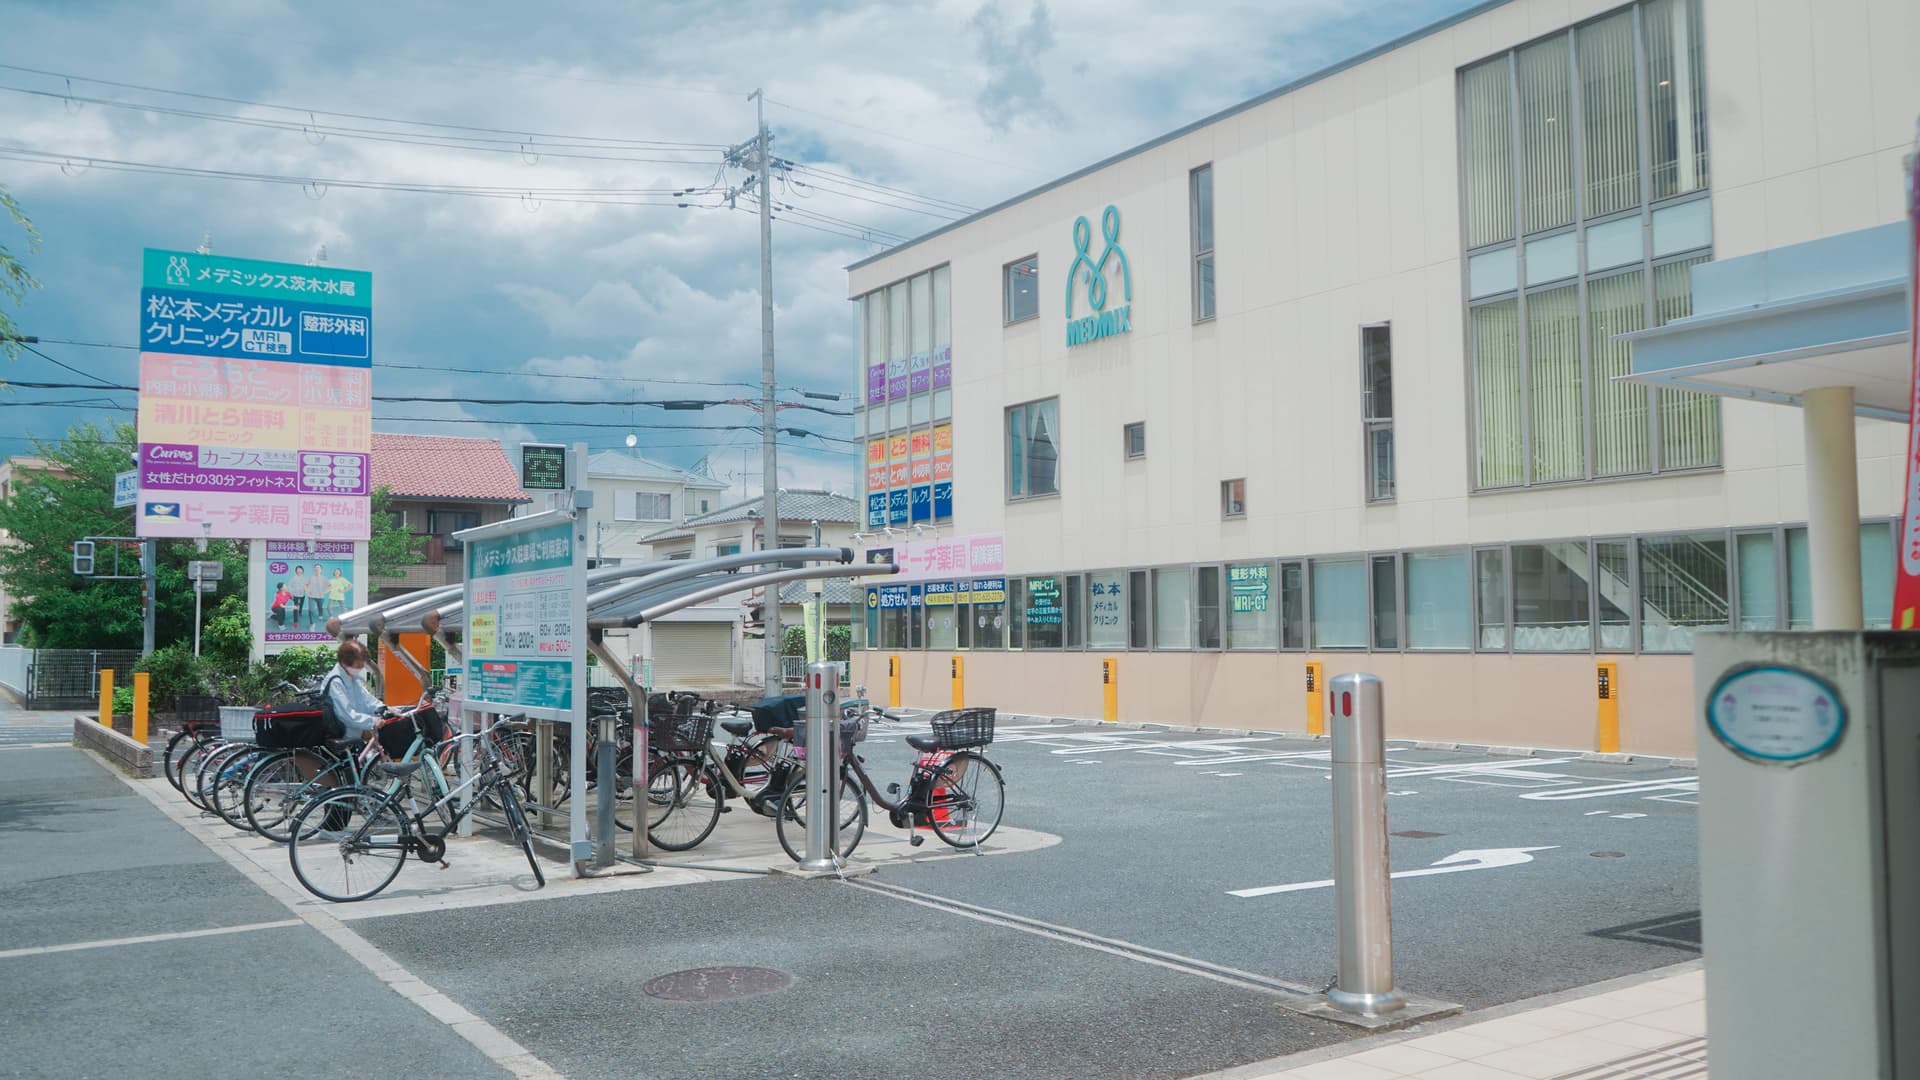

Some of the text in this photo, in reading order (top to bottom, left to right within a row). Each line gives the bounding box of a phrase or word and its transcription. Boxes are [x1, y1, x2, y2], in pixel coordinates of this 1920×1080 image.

[196, 267, 356, 296] メデミックス茨木水尾
[146, 294, 292, 328] 松本メディカル
[303, 314, 365, 337] 整形外科
[1066, 305, 1132, 348] MEDMIX
[146, 322, 240, 349] クリニック
[252, 330, 281, 343] MRI
[244, 341, 289, 354] CT検査
[186, 429, 255, 445] クリニック
[149, 446, 194, 461] Curves
[524, 449, 562, 488] 空
[146, 471, 297, 489] 女性だけの30分フィットネス
[271, 563, 287, 573] 3F
[1230, 567, 1268, 580] 整形外科
[1091, 582, 1121, 597] 松本
[1093, 614, 1119, 625] クリニック
